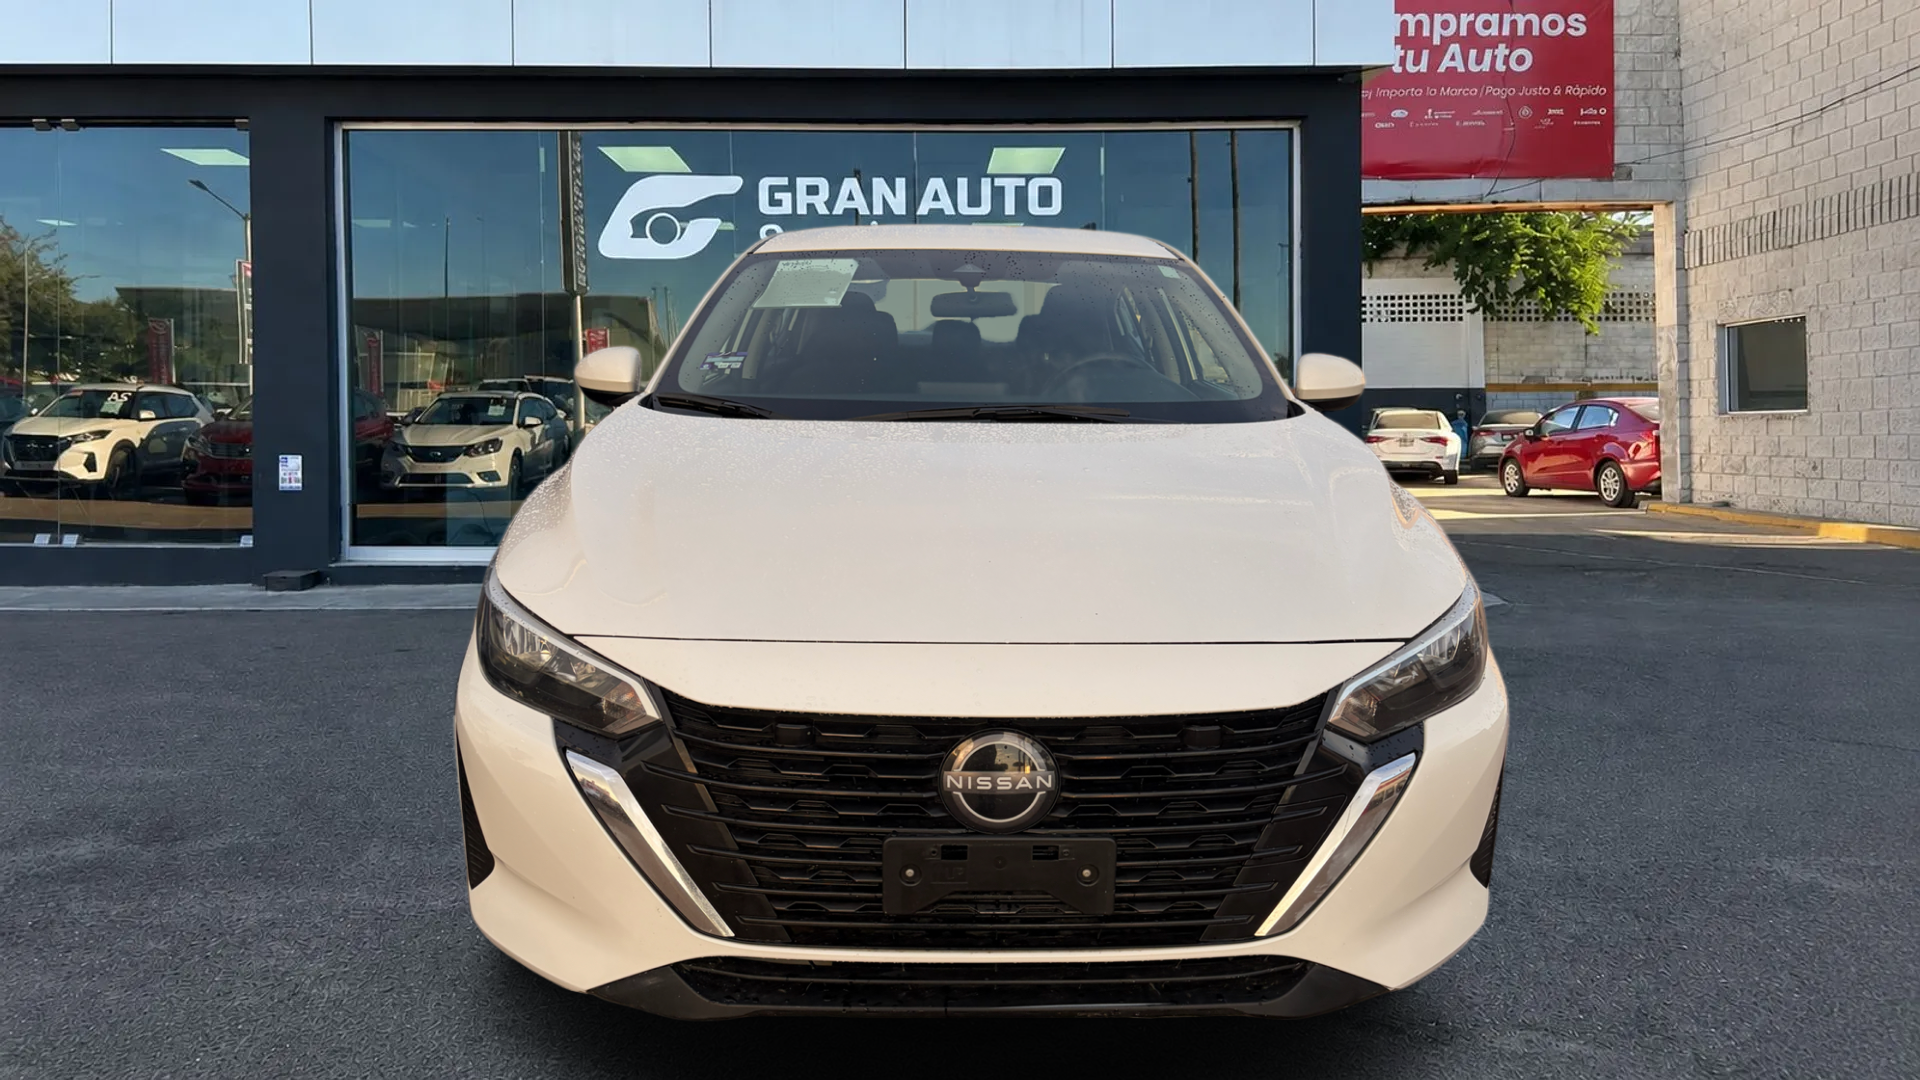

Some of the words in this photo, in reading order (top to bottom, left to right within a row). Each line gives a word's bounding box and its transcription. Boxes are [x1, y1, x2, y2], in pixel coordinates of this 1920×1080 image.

[1392, 44, 1430, 73] tu
[1437, 42, 1533, 73] Auto
[1375, 87, 1423, 99] Importa
[1426, 86, 1437, 97] la
[1439, 86, 1478, 97] Marca
[1518, 85, 1551, 96] Justo
[1553, 85, 1562, 96] &
[758, 176, 907, 216] GRAN
[916, 176, 1063, 216] AUTO
[947, 774, 1052, 790] NISSAN
